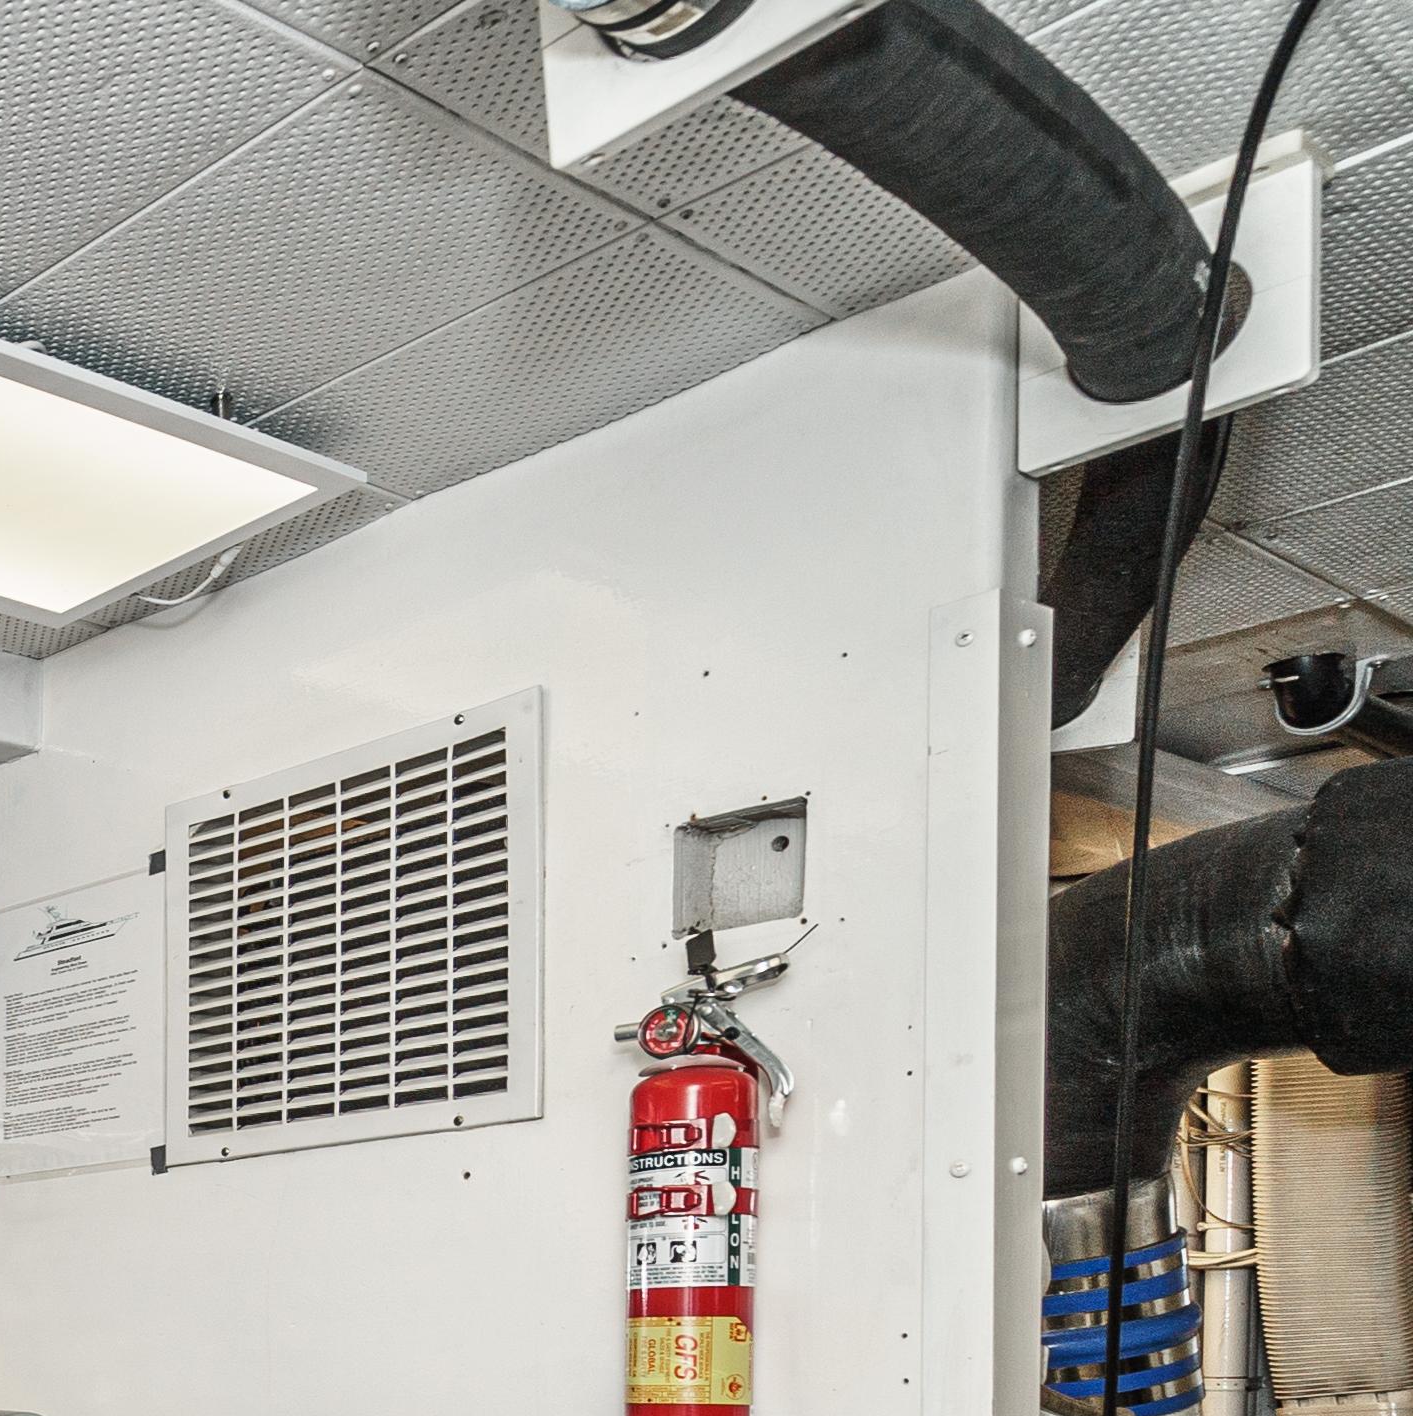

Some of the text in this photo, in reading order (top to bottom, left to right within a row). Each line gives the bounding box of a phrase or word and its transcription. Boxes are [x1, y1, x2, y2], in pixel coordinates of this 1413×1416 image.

[629, 1152, 725, 1171] STRUCTIONS
[729, 1166, 741, 1269] HLON
[647, 1338, 657, 1374] GLOBAL
[673, 1334, 698, 1380] GFS
